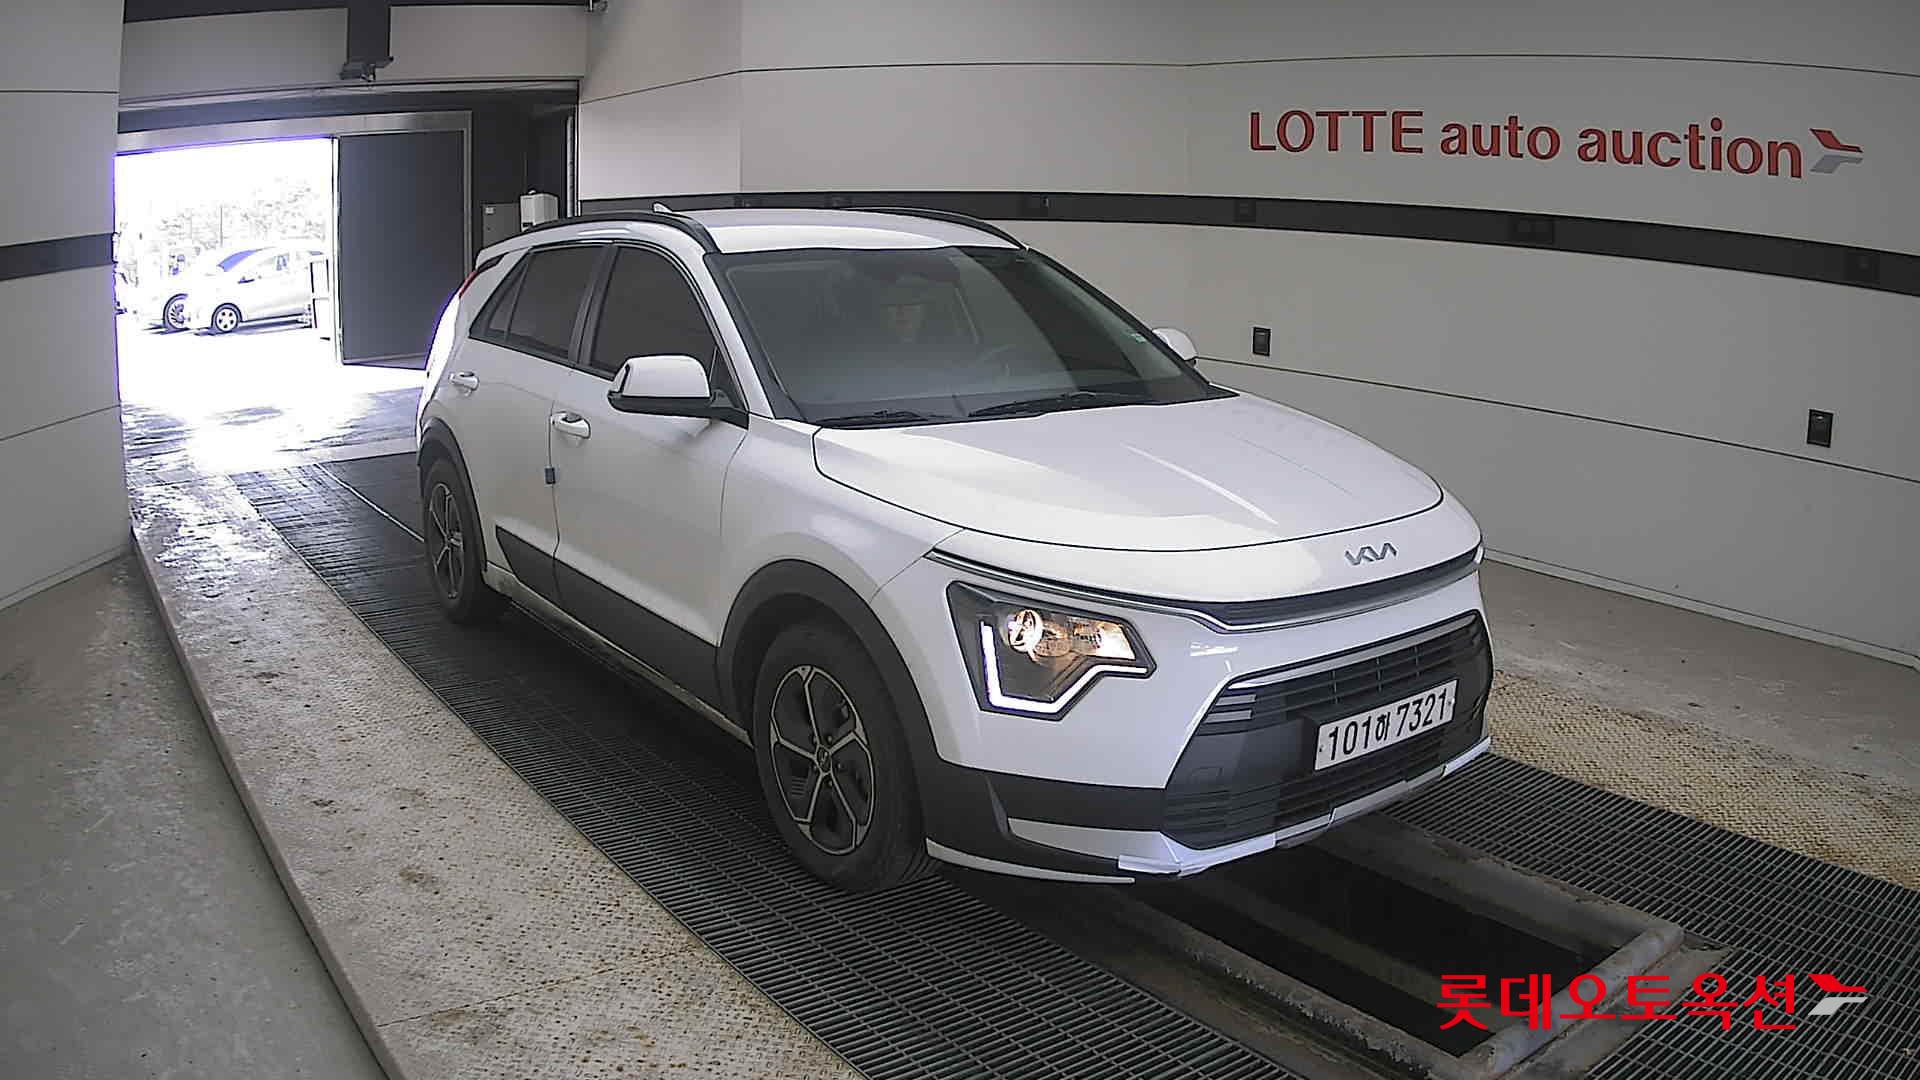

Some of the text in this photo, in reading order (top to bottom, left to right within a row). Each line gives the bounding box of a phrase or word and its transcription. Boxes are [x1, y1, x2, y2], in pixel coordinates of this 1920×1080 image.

[1249, 110, 1802, 178] LOTTE auto auction
